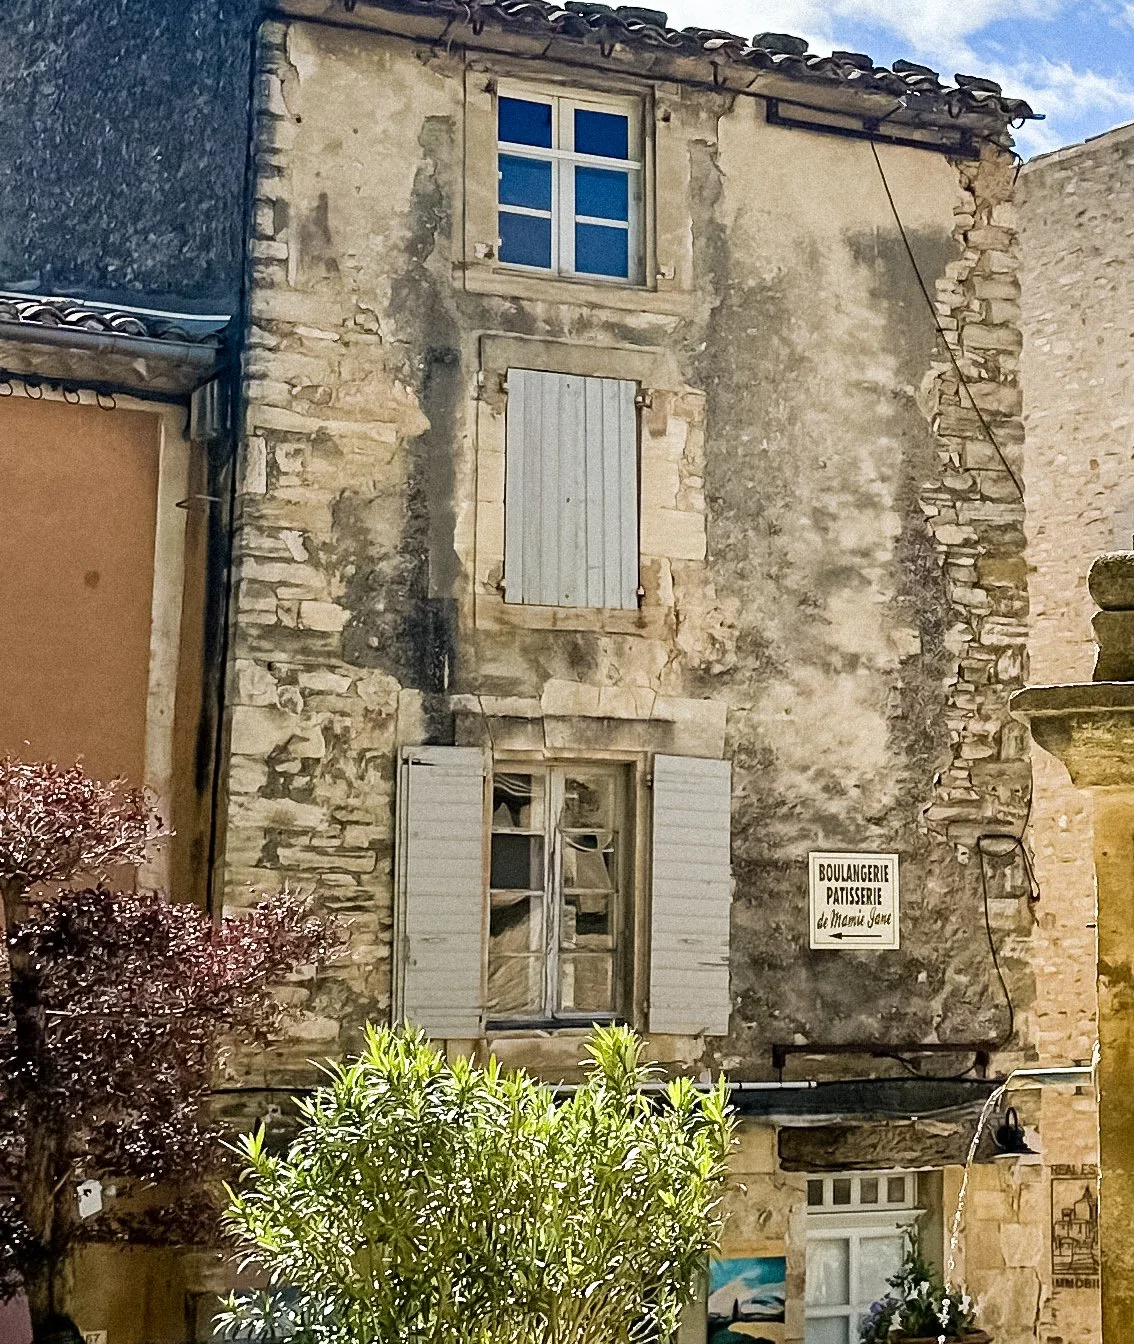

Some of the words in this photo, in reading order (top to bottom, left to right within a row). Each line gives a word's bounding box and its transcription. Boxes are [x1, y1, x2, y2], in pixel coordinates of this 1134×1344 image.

[818, 863, 889, 883] BOULANGERIE
[826, 886, 882, 906] PATISSERIE
[816, 911, 829, 930] de
[830, 908, 865, 929] Mamie
